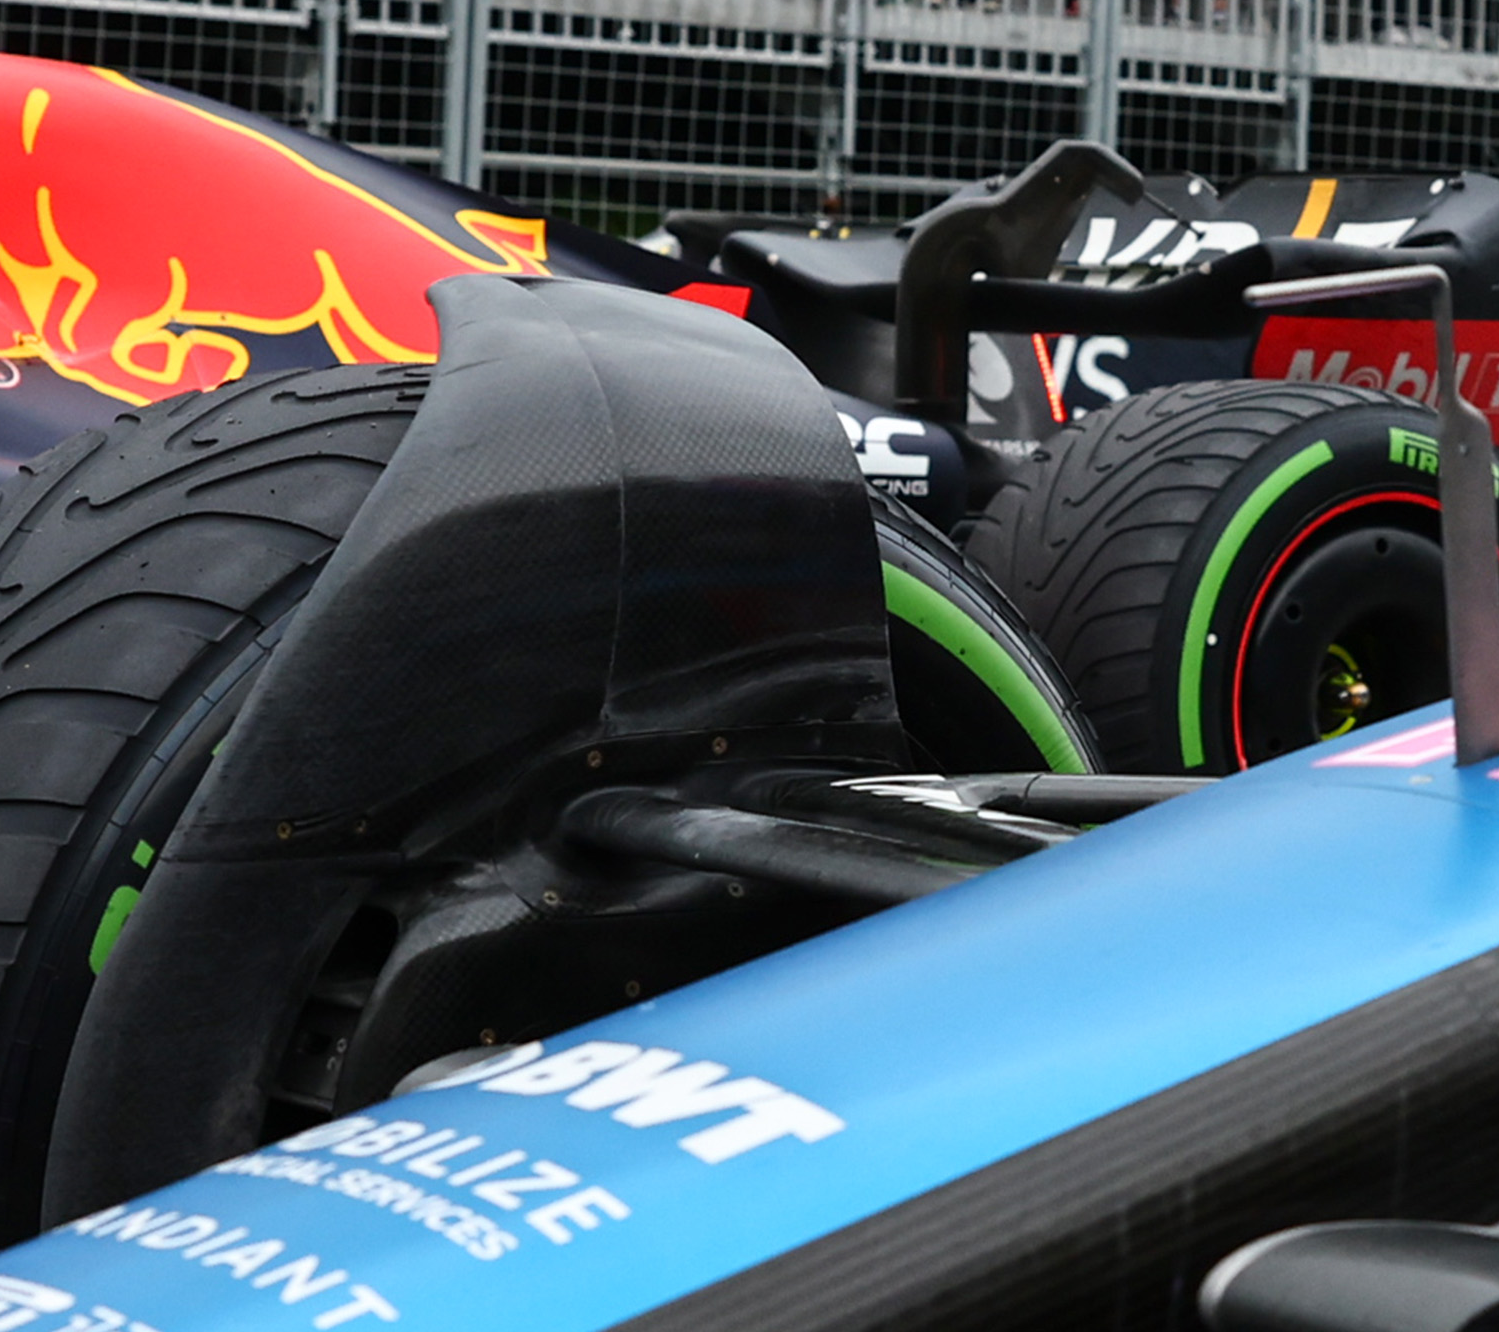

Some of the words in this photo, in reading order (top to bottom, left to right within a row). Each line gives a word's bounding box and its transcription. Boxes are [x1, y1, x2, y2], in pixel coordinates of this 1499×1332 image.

[478, 1039, 848, 1165] BWT
[277, 1115, 633, 1245] OBILIZE
[323, 1168, 520, 1263] SERVICES
[76, 1204, 401, 1331] ANDIANT
